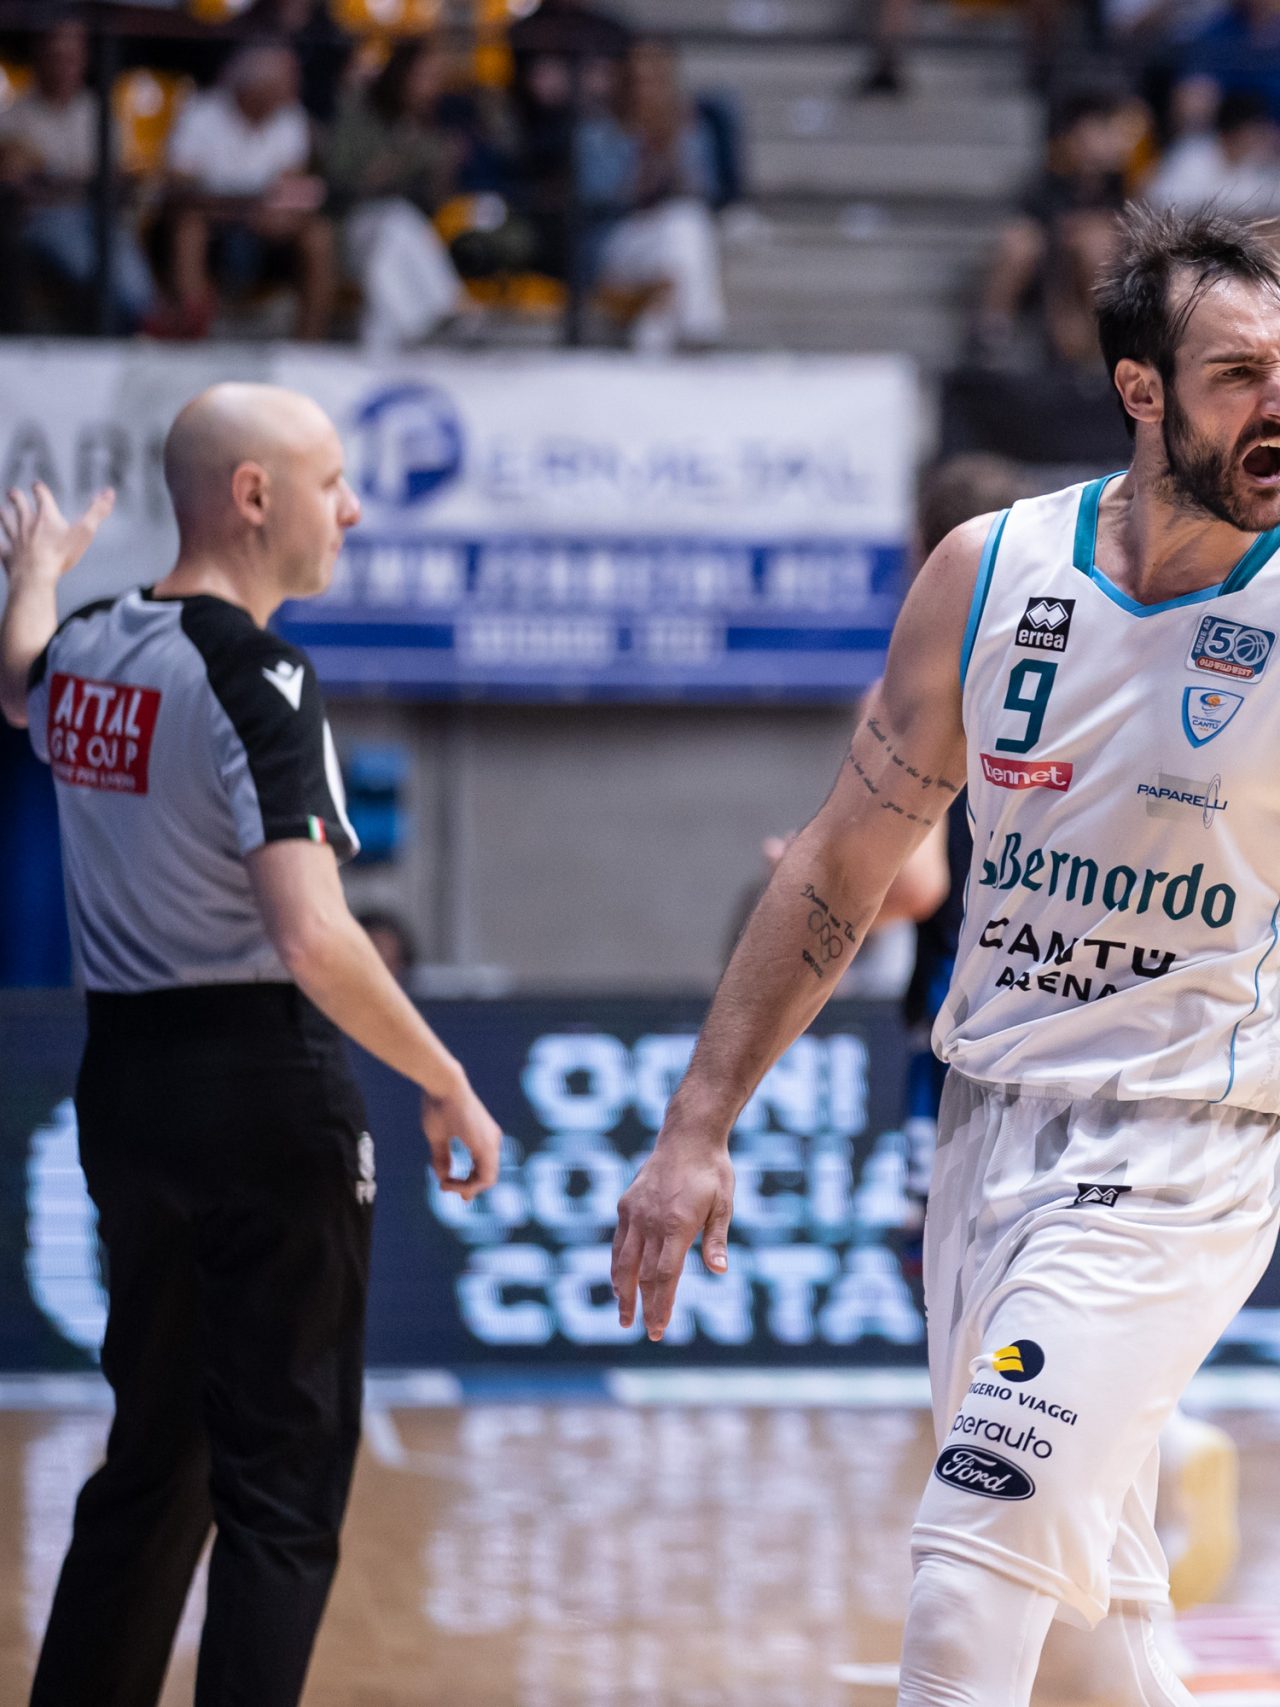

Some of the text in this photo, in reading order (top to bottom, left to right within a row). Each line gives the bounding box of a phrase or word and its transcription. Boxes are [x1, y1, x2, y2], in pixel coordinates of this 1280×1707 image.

[995, 658, 1058, 754] 9
[51, 726, 138, 770] GROUP
[983, 758, 1067, 786] bennet
[995, 966, 1118, 1002] ARENA
[455, 1244, 926, 1346] CONTA
[1018, 1392, 1078, 1426] VIAGGI
[950, 1407, 1053, 1459] perauto
[942, 1450, 1012, 1492] Ford
